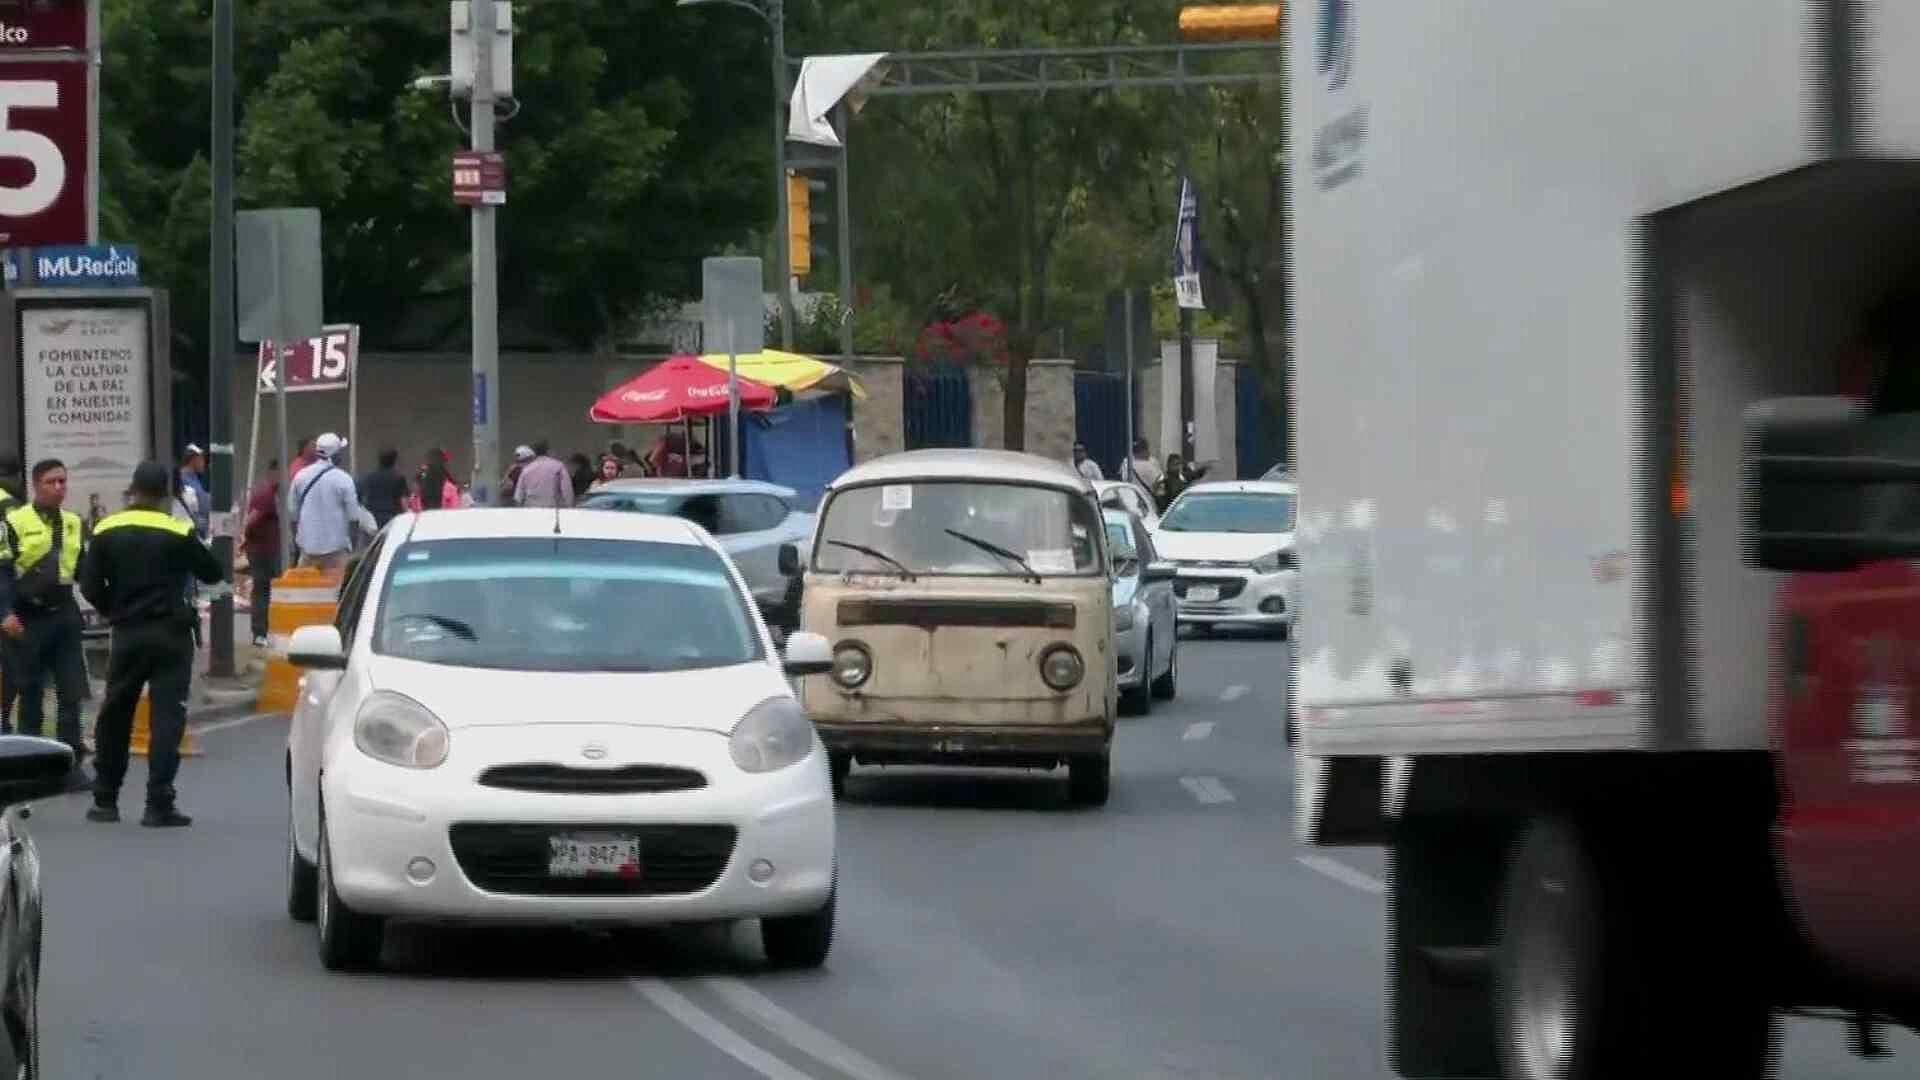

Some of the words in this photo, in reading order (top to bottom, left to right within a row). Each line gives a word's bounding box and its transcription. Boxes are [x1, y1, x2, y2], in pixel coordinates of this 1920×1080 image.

[39, 348, 132, 362] FOMENTEMOS
[309, 334, 346, 379] 15
[46, 365, 65, 377] LA
[70, 364, 128, 377] CULTURA
[54, 380, 73, 393] DE
[79, 380, 98, 392] LA
[102, 379, 124, 391] PAZ
[46, 397, 66, 410] EN
[72, 395, 130, 409] NUESTRA
[47, 410, 131, 424] COMUNIDAD
